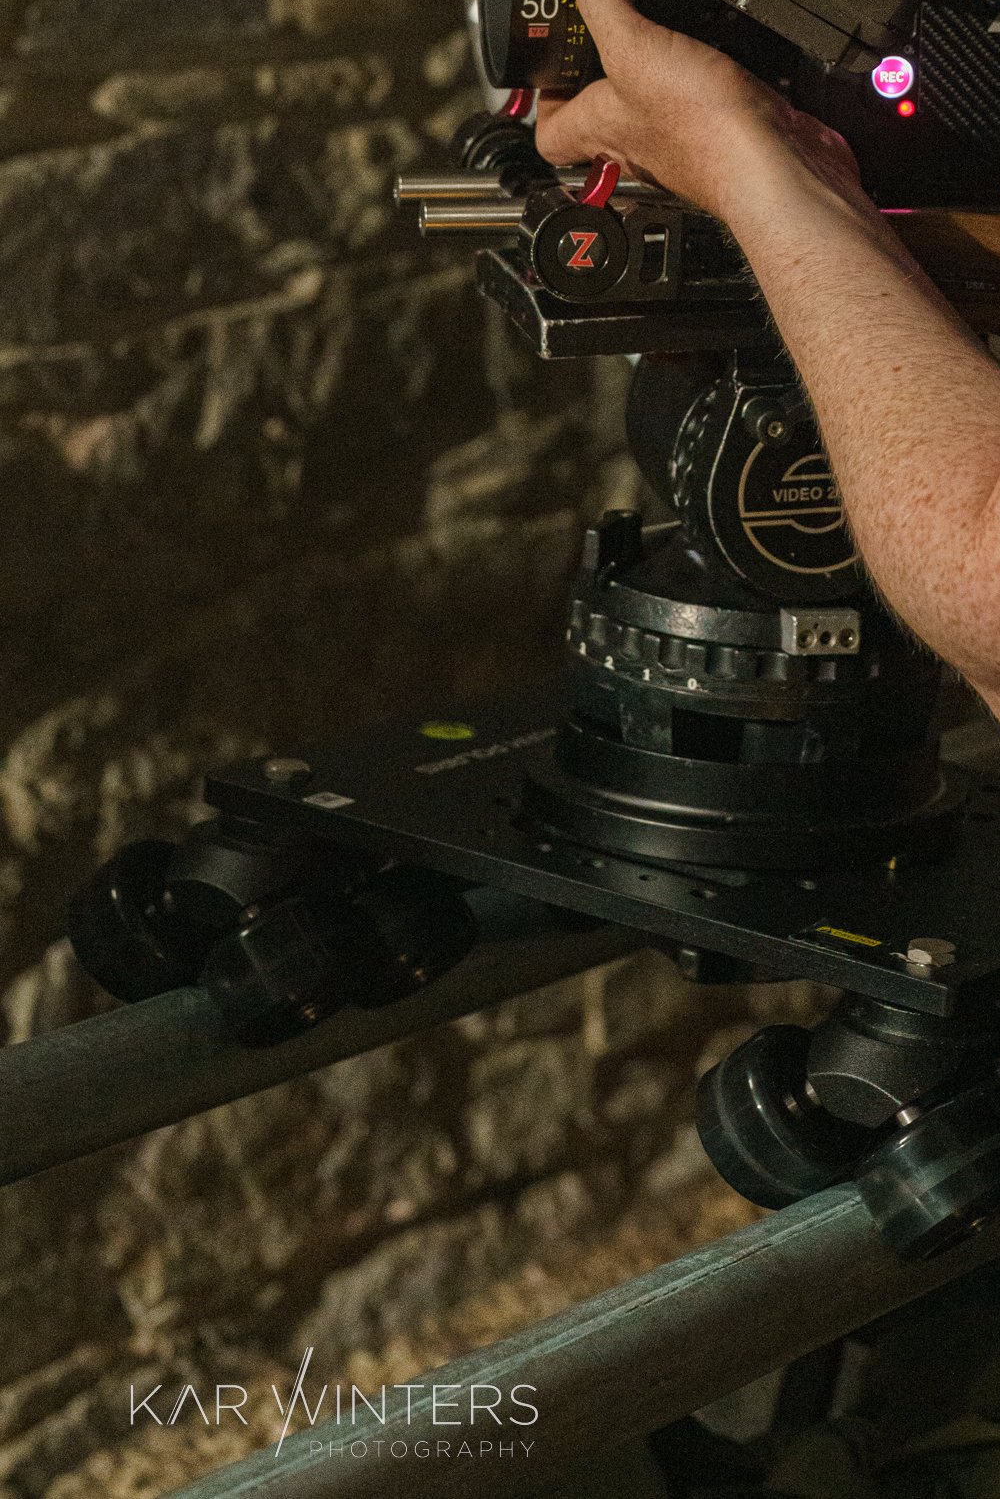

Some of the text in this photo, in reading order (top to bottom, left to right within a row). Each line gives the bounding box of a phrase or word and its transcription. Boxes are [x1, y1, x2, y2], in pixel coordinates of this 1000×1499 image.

[879, 70, 905, 83] REC
[566, 231, 599, 268] Z
[773, 487, 824, 503] VIDEO
[603, 655, 616, 671] 2
[642, 668, 650, 681] 1
[687, 678, 697, 690] 0
